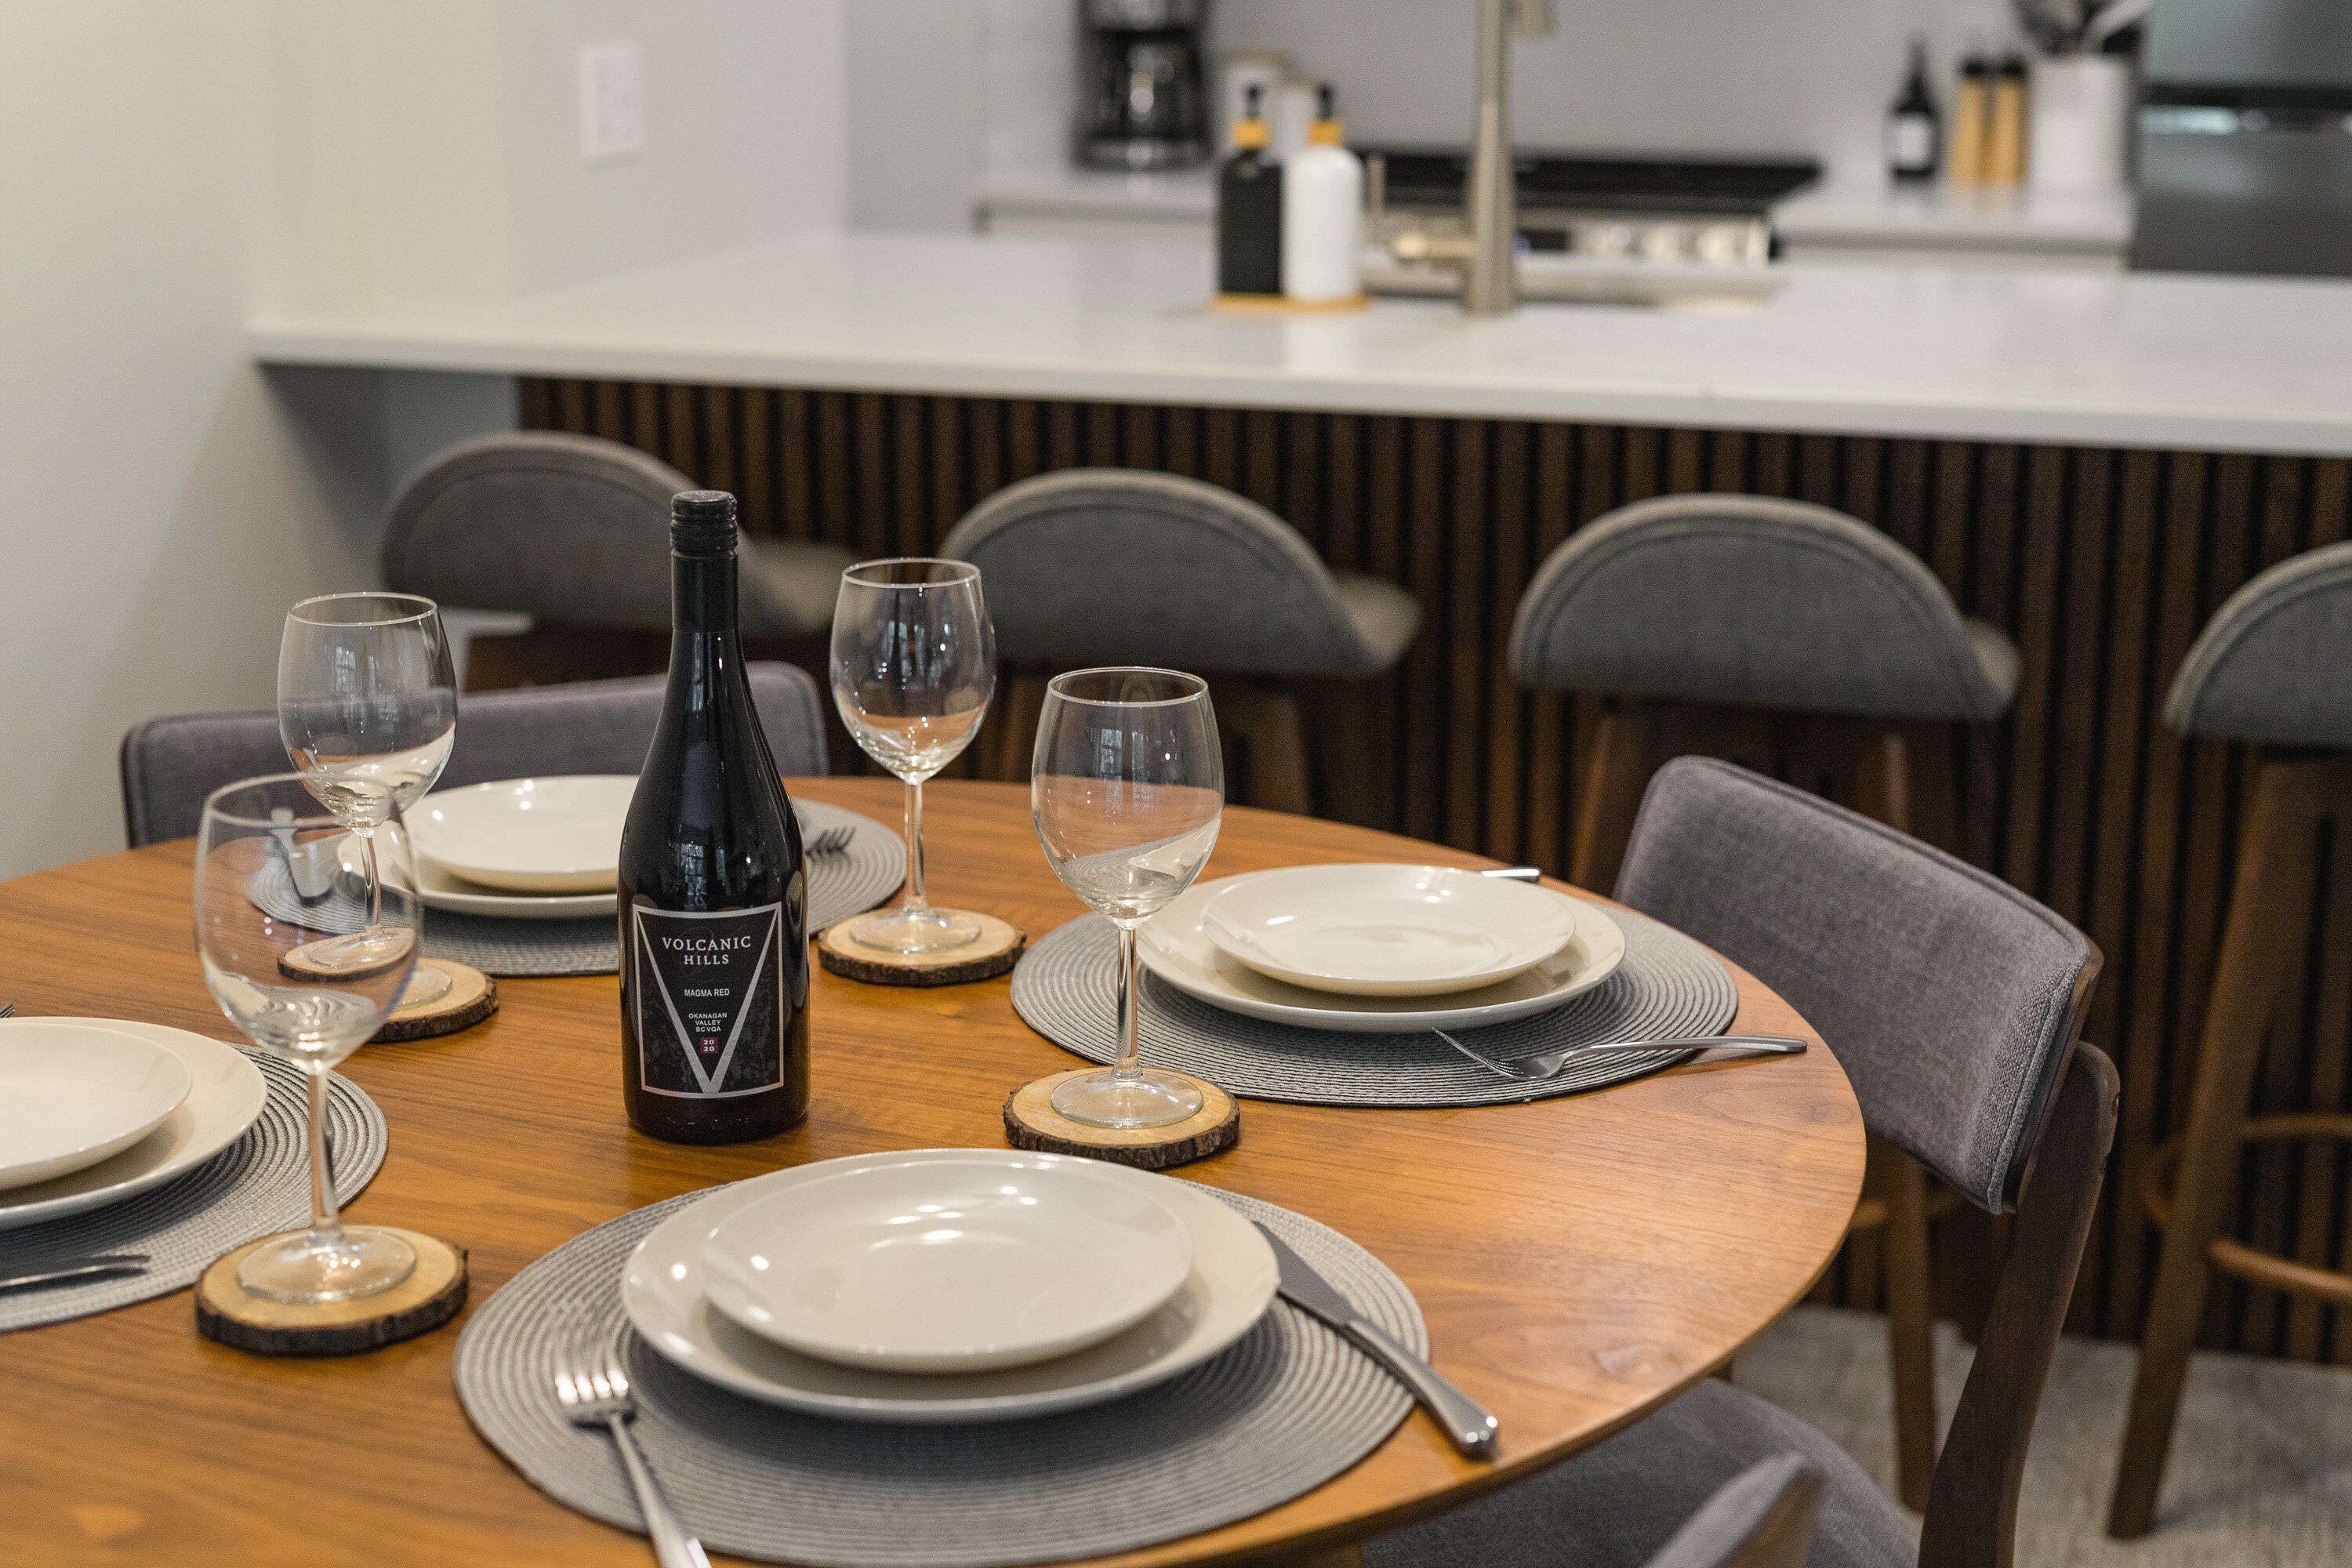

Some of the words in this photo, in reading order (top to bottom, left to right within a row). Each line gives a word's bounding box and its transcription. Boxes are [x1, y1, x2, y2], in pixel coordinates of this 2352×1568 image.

[662, 935, 751, 951] VOLCANIC
[684, 954, 729, 965] HILLS
[684, 989, 713, 997] MAGMA
[713, 988, 730, 996] RED
